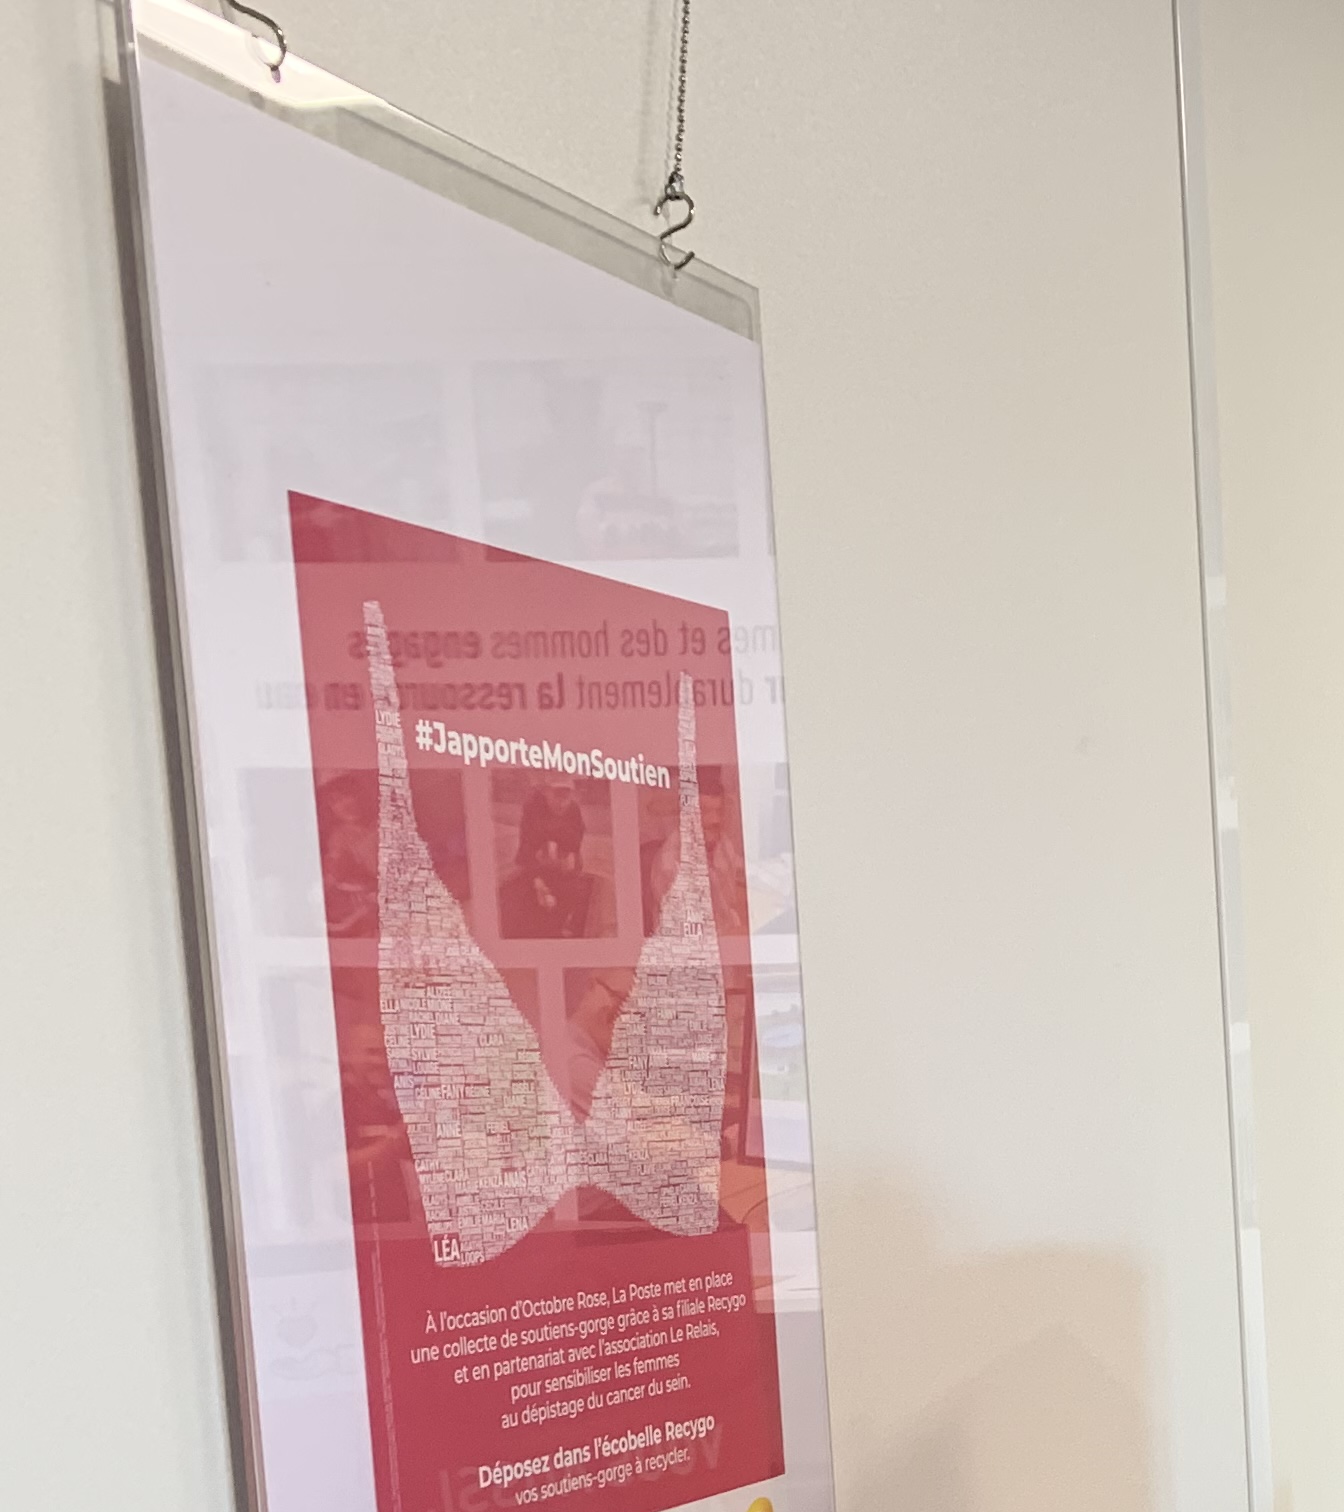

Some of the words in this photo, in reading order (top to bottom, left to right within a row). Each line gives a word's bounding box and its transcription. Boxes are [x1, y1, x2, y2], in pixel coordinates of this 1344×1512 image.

[414, 718, 672, 790] #JapporteMonSoutien
[411, 1343, 440, 1365] une
[442, 1330, 498, 1358] collecte
[500, 1327, 518, 1347] de
[521, 1310, 615, 1348] soutiens-gorge
[617, 1306, 650, 1334] grâce
[652, 1304, 661, 1322] à
[662, 1305, 674, 1320] sa
[675, 1297, 706, 1319] filiale
[707, 1292, 747, 1318] Recygo
[425, 1312, 437, 1334] À
[440, 1303, 508, 1330] l'occasion
[510, 1293, 574, 1320] d'Octobre
[577, 1288, 610, 1309] Rose,
[612, 1285, 627, 1304] La
[629, 1280, 662, 1301] Poste
[664, 1277, 686, 1294] met
[688, 1277, 703, 1291] en
[705, 1269, 734, 1293] place
[454, 1365, 470, 1384] et
[472, 1362, 491, 1380] en
[493, 1347, 566, 1379] partenariat
[567, 1343, 598, 1363] avec
[598, 1328, 669, 1357] l'association
[670, 1325, 684, 1343] Le
[685, 1318, 721, 1341] Relais,
[510, 1379, 542, 1404] pour
[545, 1362, 612, 1395] sensibiliser
[614, 1361, 631, 1379] les
[633, 1352, 681, 1375] femmes
[501, 1412, 519, 1430] au
[521, 1394, 585, 1427] dépistage
[586, 1391, 604, 1410] du
[605, 1384, 646, 1406] cancer
[648, 1380, 665, 1398] du
[666, 1374, 692, 1394] sein.
[478, 1456, 550, 1492] Déposez
[553, 1444, 591, 1473] dans
[594, 1423, 663, 1462] l'écobelle
[665, 1413, 716, 1443] Recygo
[515, 1487, 540, 1506] vos
[541, 1459, 634, 1501] soutiens-gorge
[635, 1456, 644, 1476] à
[644, 1447, 692, 1474] recycler.
